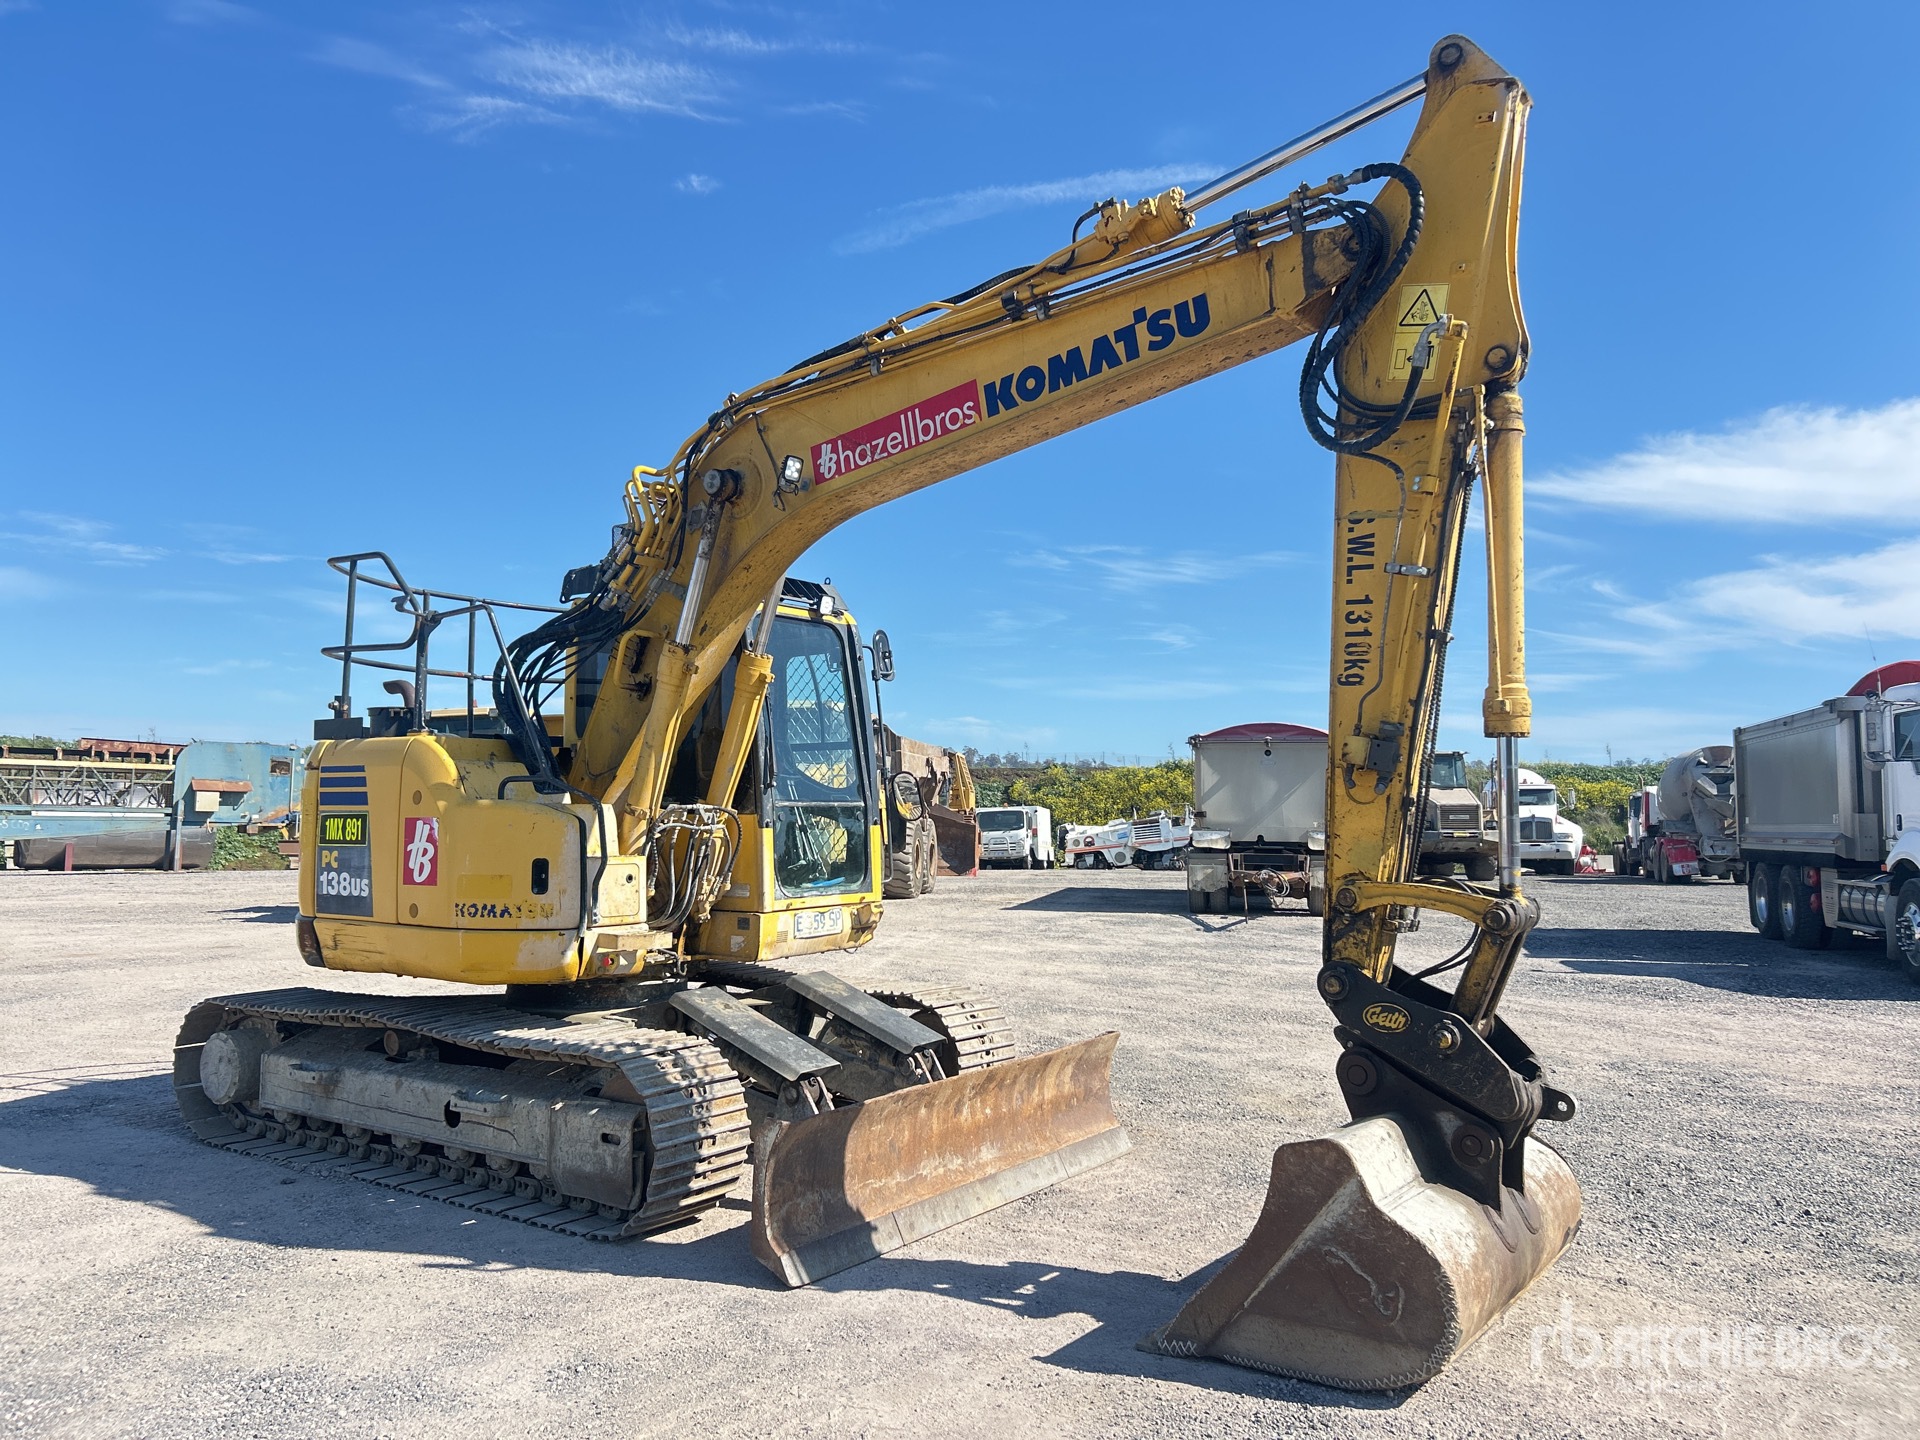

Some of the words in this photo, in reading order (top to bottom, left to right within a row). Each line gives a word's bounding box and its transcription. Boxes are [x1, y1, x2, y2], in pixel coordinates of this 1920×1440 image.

[983, 293, 1211, 419] KOMATSU
[345, 818, 362, 841] 891
[321, 850, 339, 869] PC
